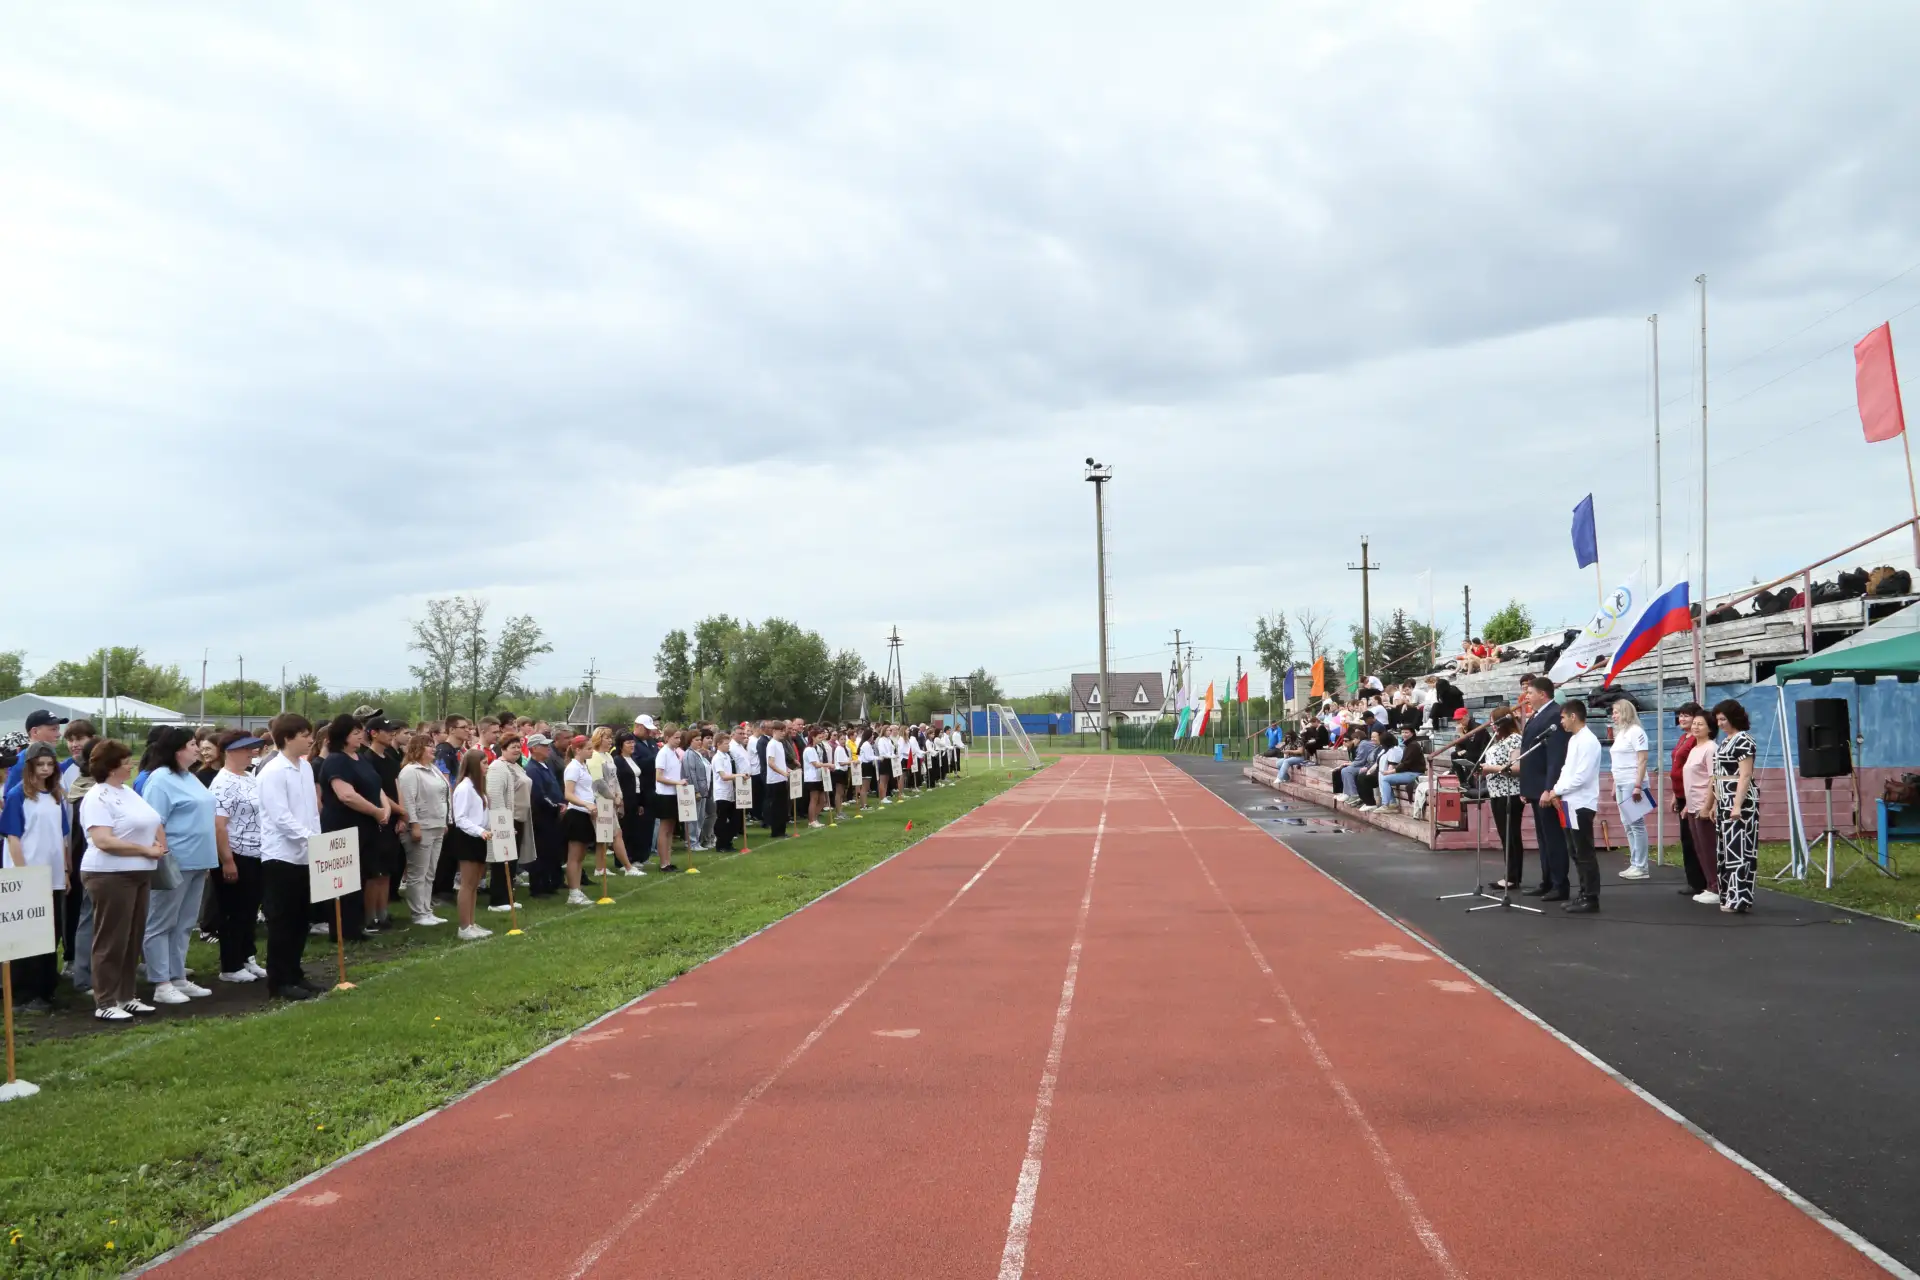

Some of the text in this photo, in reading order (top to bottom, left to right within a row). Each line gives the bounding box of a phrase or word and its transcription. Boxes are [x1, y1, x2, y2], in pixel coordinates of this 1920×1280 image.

[329, 838, 346, 851] МБОУ
[333, 876, 343, 889] СШ
[27, 906, 45, 919] ОШ
